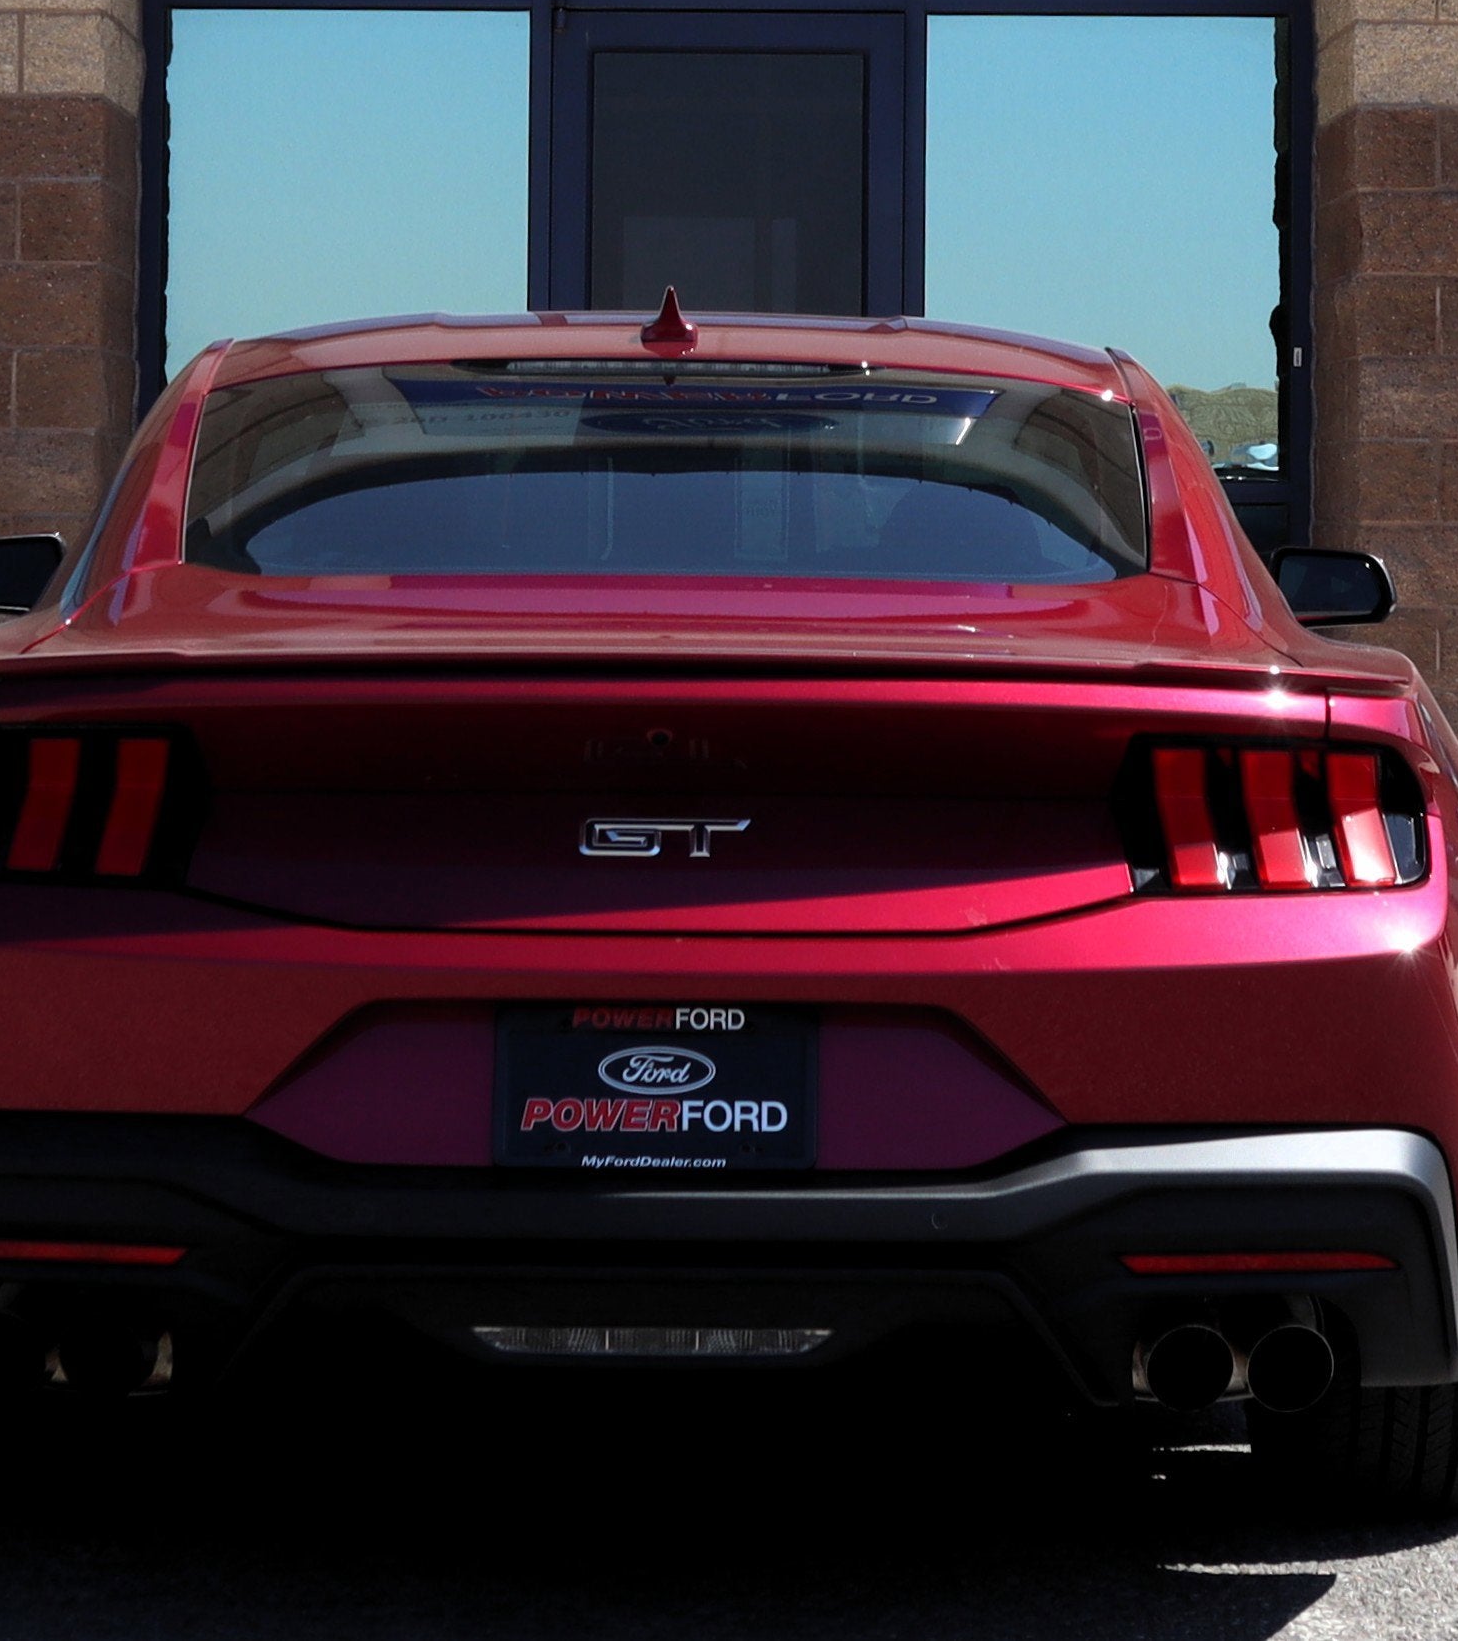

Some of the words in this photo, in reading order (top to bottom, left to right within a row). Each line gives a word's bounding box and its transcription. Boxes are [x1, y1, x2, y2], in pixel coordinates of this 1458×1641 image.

[578, 817, 752, 858] GT
[572, 1007, 746, 1031] POWERFORD
[621, 1054, 691, 1085] Ford
[520, 1097, 788, 1132] POWERFORD
[581, 1154, 727, 1169] MyFordDealer.com
